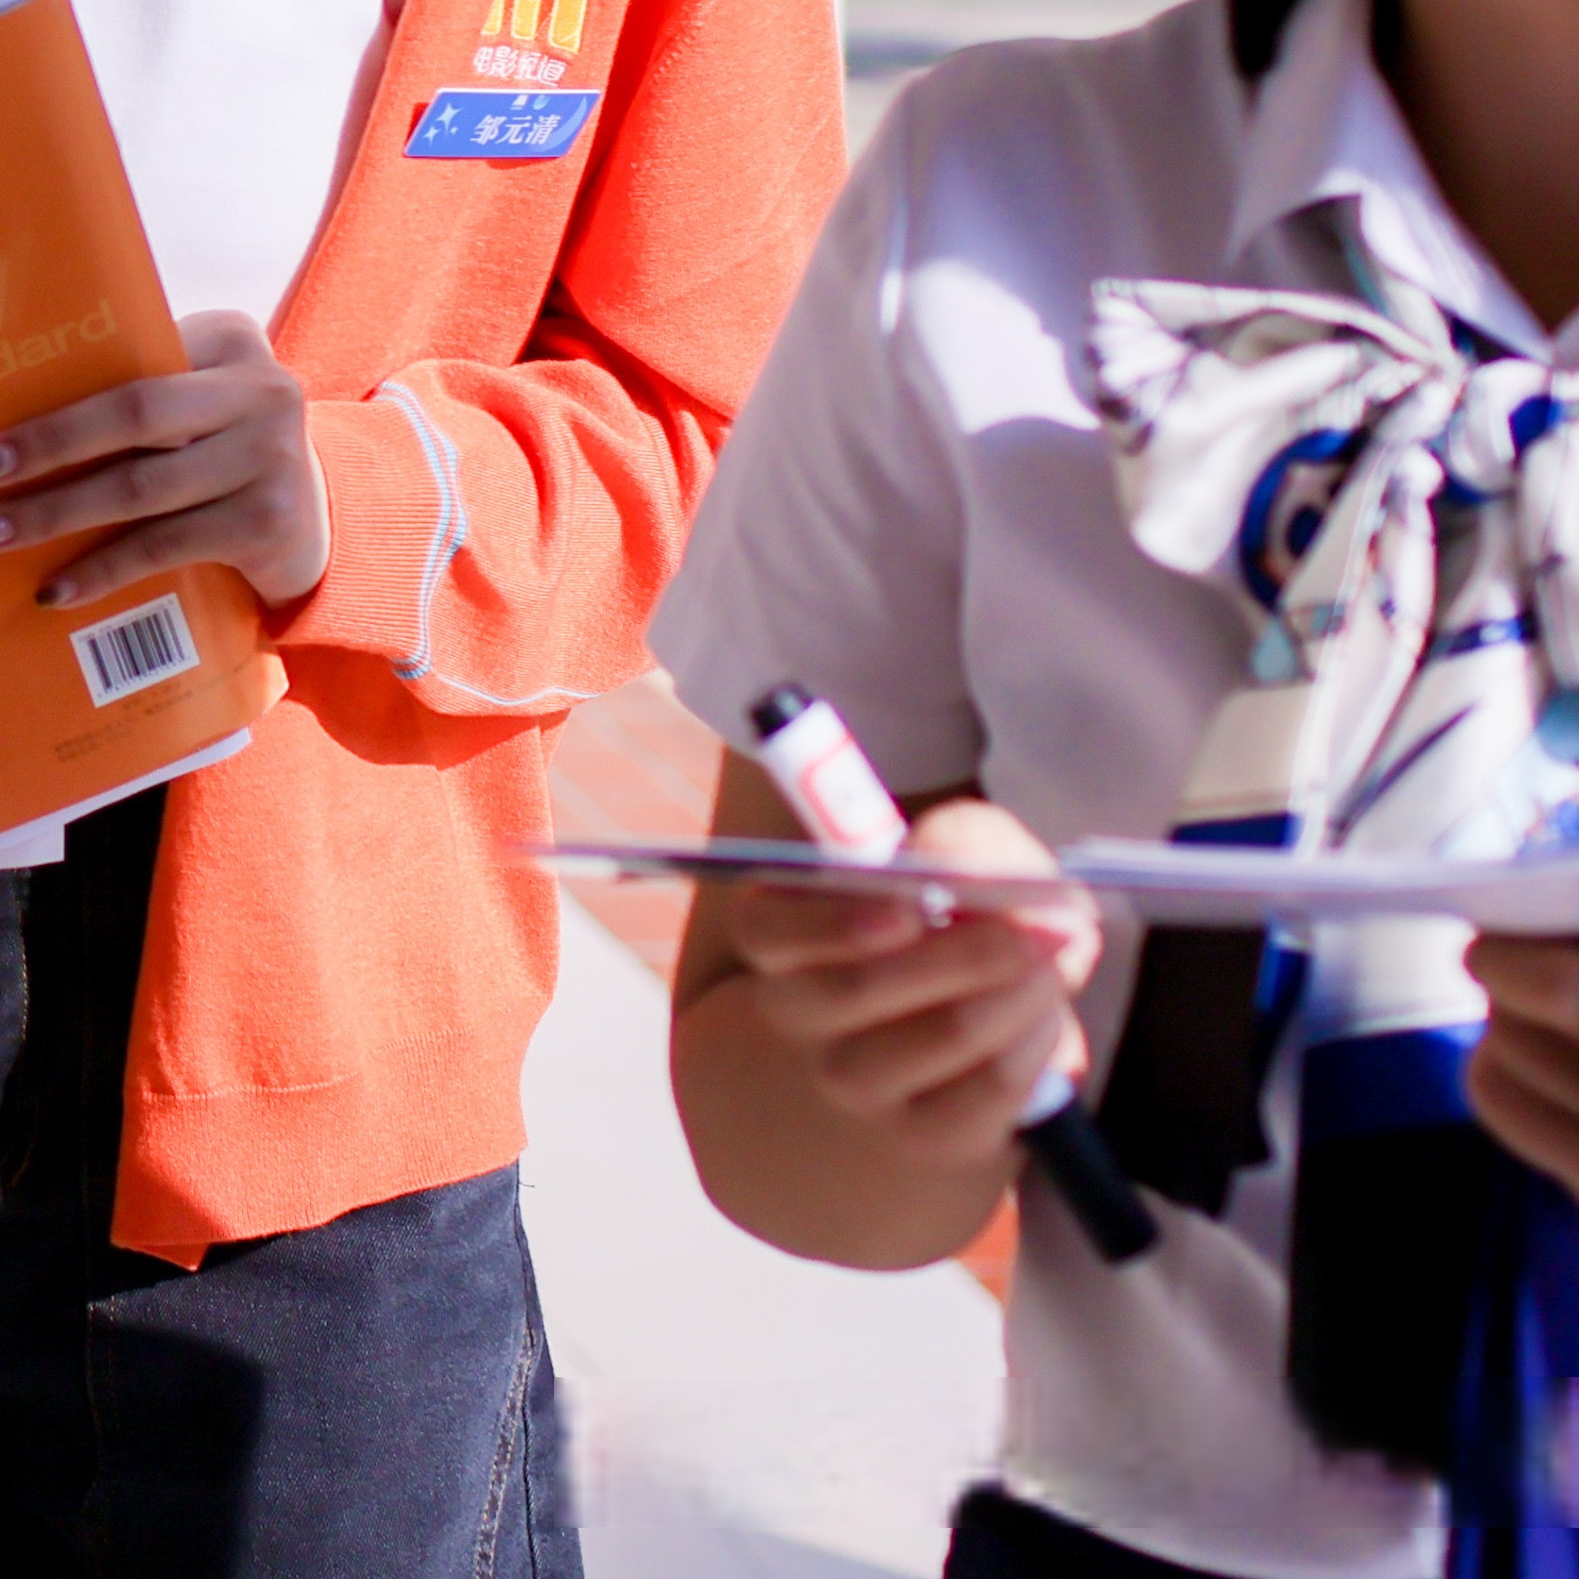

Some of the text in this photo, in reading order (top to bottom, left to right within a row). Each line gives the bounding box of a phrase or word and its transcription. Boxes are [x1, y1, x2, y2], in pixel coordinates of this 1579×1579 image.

[473, 45, 567, 87] 电影频道
[470, 114, 561, 145] 邹元清
